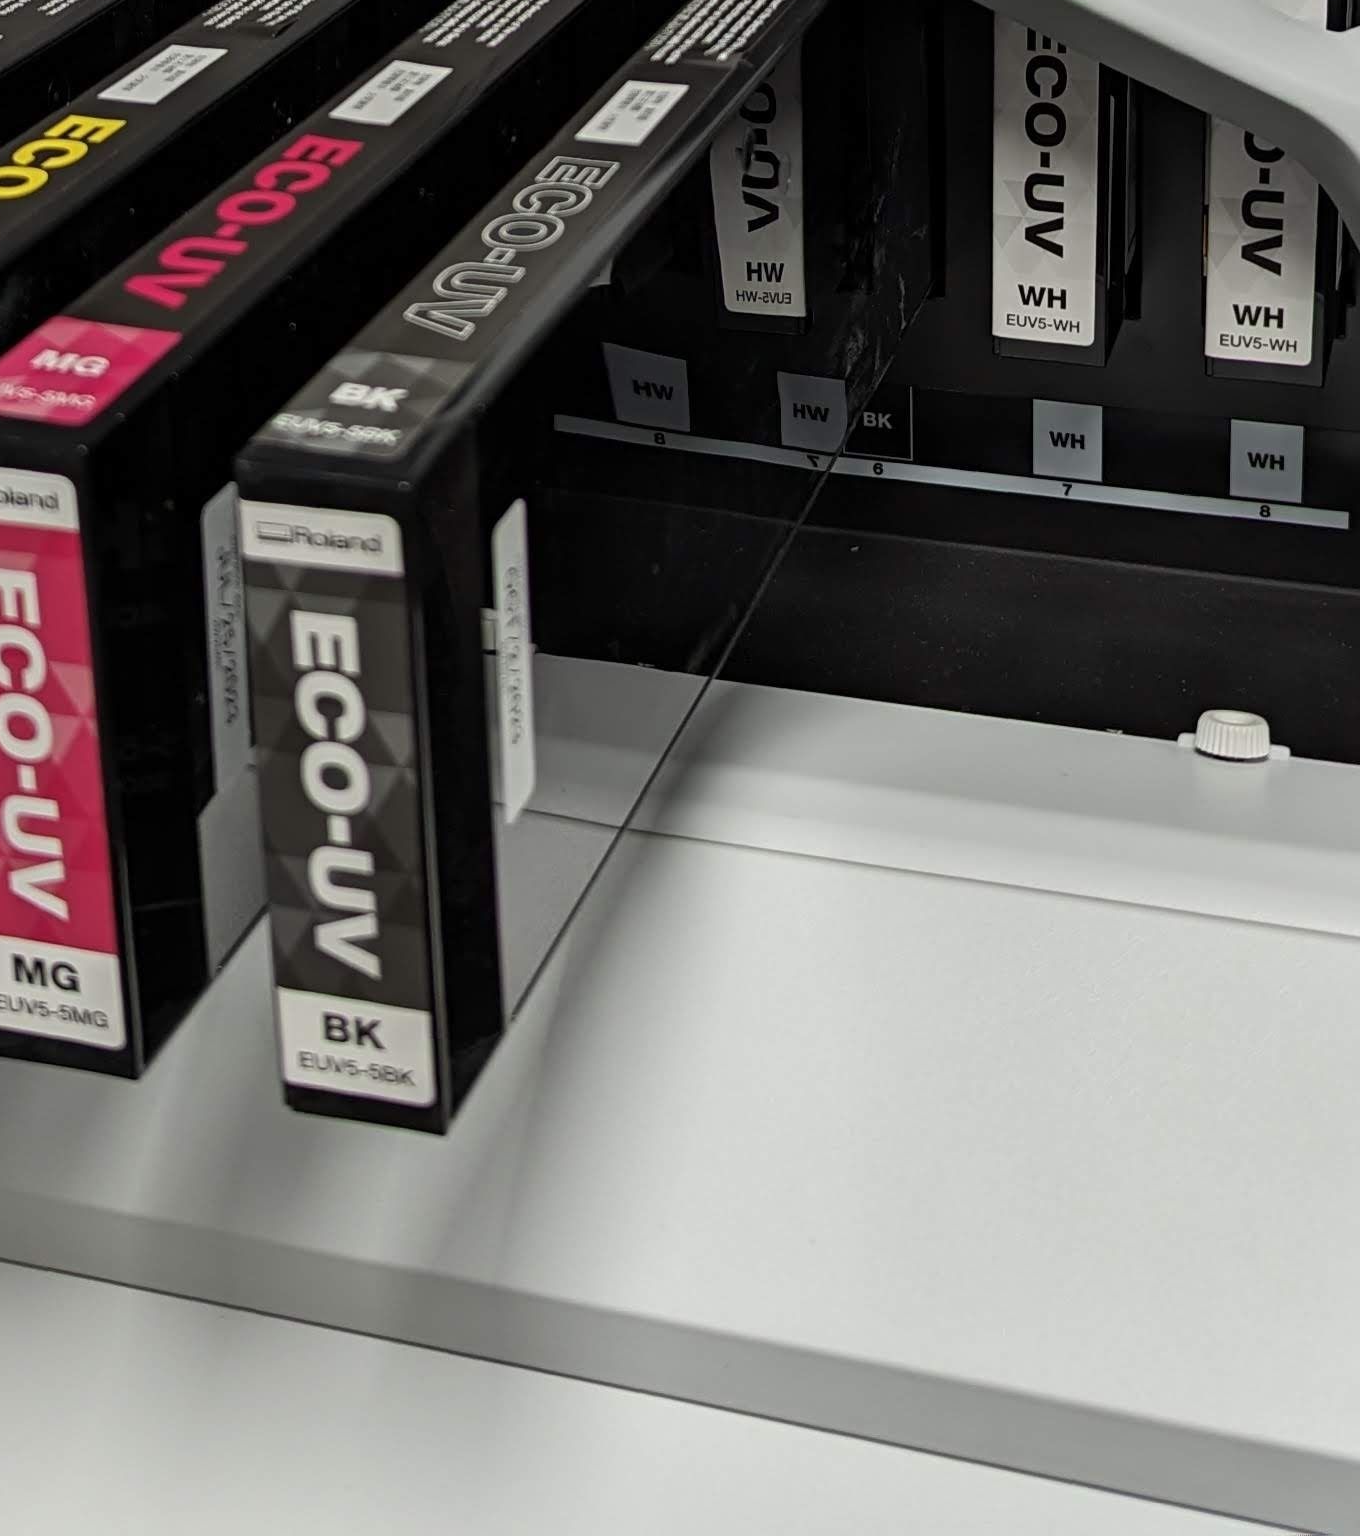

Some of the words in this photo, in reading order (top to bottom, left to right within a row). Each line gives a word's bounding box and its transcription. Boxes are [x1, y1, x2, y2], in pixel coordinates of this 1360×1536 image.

[124, 134, 365, 311] ECO-UV
[403, 155, 621, 341] ECO-UV
[1017, 284, 1067, 310] WH
[1005, 313, 1081, 334] EUV5-WH
[1232, 303, 1285, 329] WH
[1219, 333, 1298, 353] EUV5-WH
[29, 348, 111, 378] MG
[328, 381, 410, 413] BK
[863, 411, 893, 430] BK
[1049, 430, 1086, 450] WH
[873, 462, 884, 475] 6
[1247, 451, 1285, 471] WH
[1062, 483, 1073, 496] 7
[1259, 505, 1271, 518] 8
[293, 524, 384, 556] Roland
[290, 610, 384, 981] ECO-UV
[12, 953, 81, 994] MG
[323, 1014, 384, 1052] BK
[298, 1049, 418, 1089] EUV5-5BK
